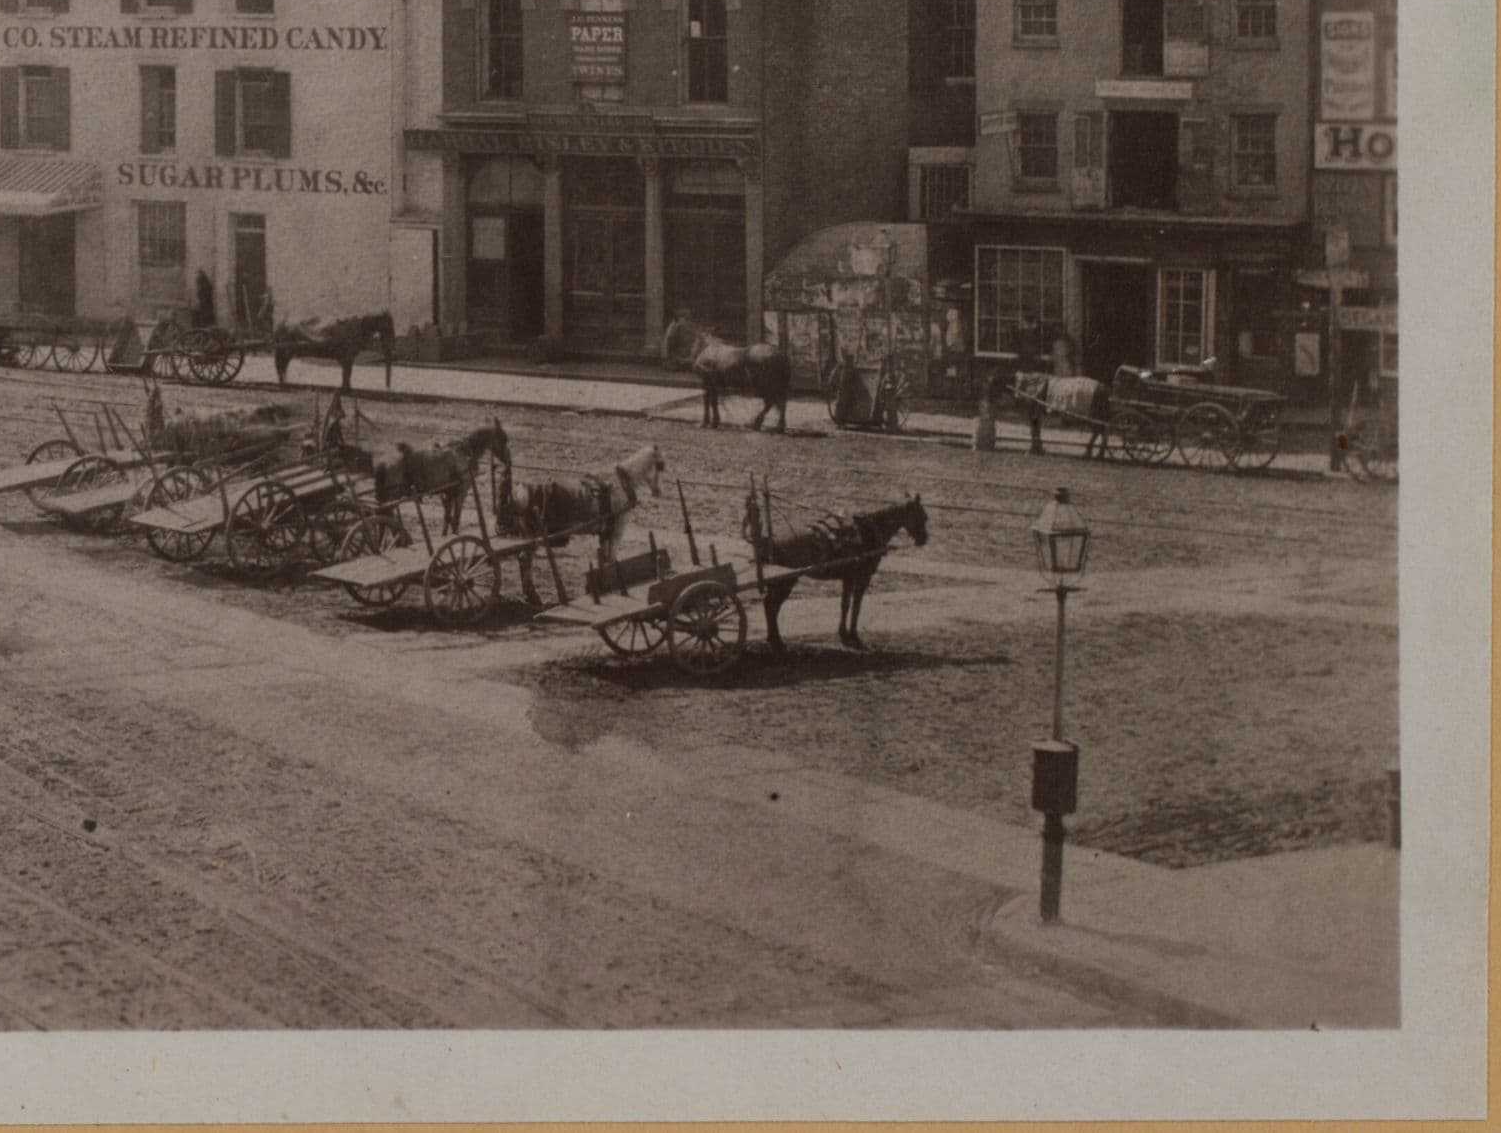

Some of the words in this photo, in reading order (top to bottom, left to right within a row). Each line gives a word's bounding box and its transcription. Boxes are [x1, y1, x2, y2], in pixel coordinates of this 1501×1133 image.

[3, 26, 42, 48] CO.
[49, 26, 143, 49] STEAM
[150, 26, 279, 50] REFINED
[571, 26, 624, 43] PAPER
[117, 162, 224, 189] SUGAR
[231, 167, 349, 195] PLUMS,
